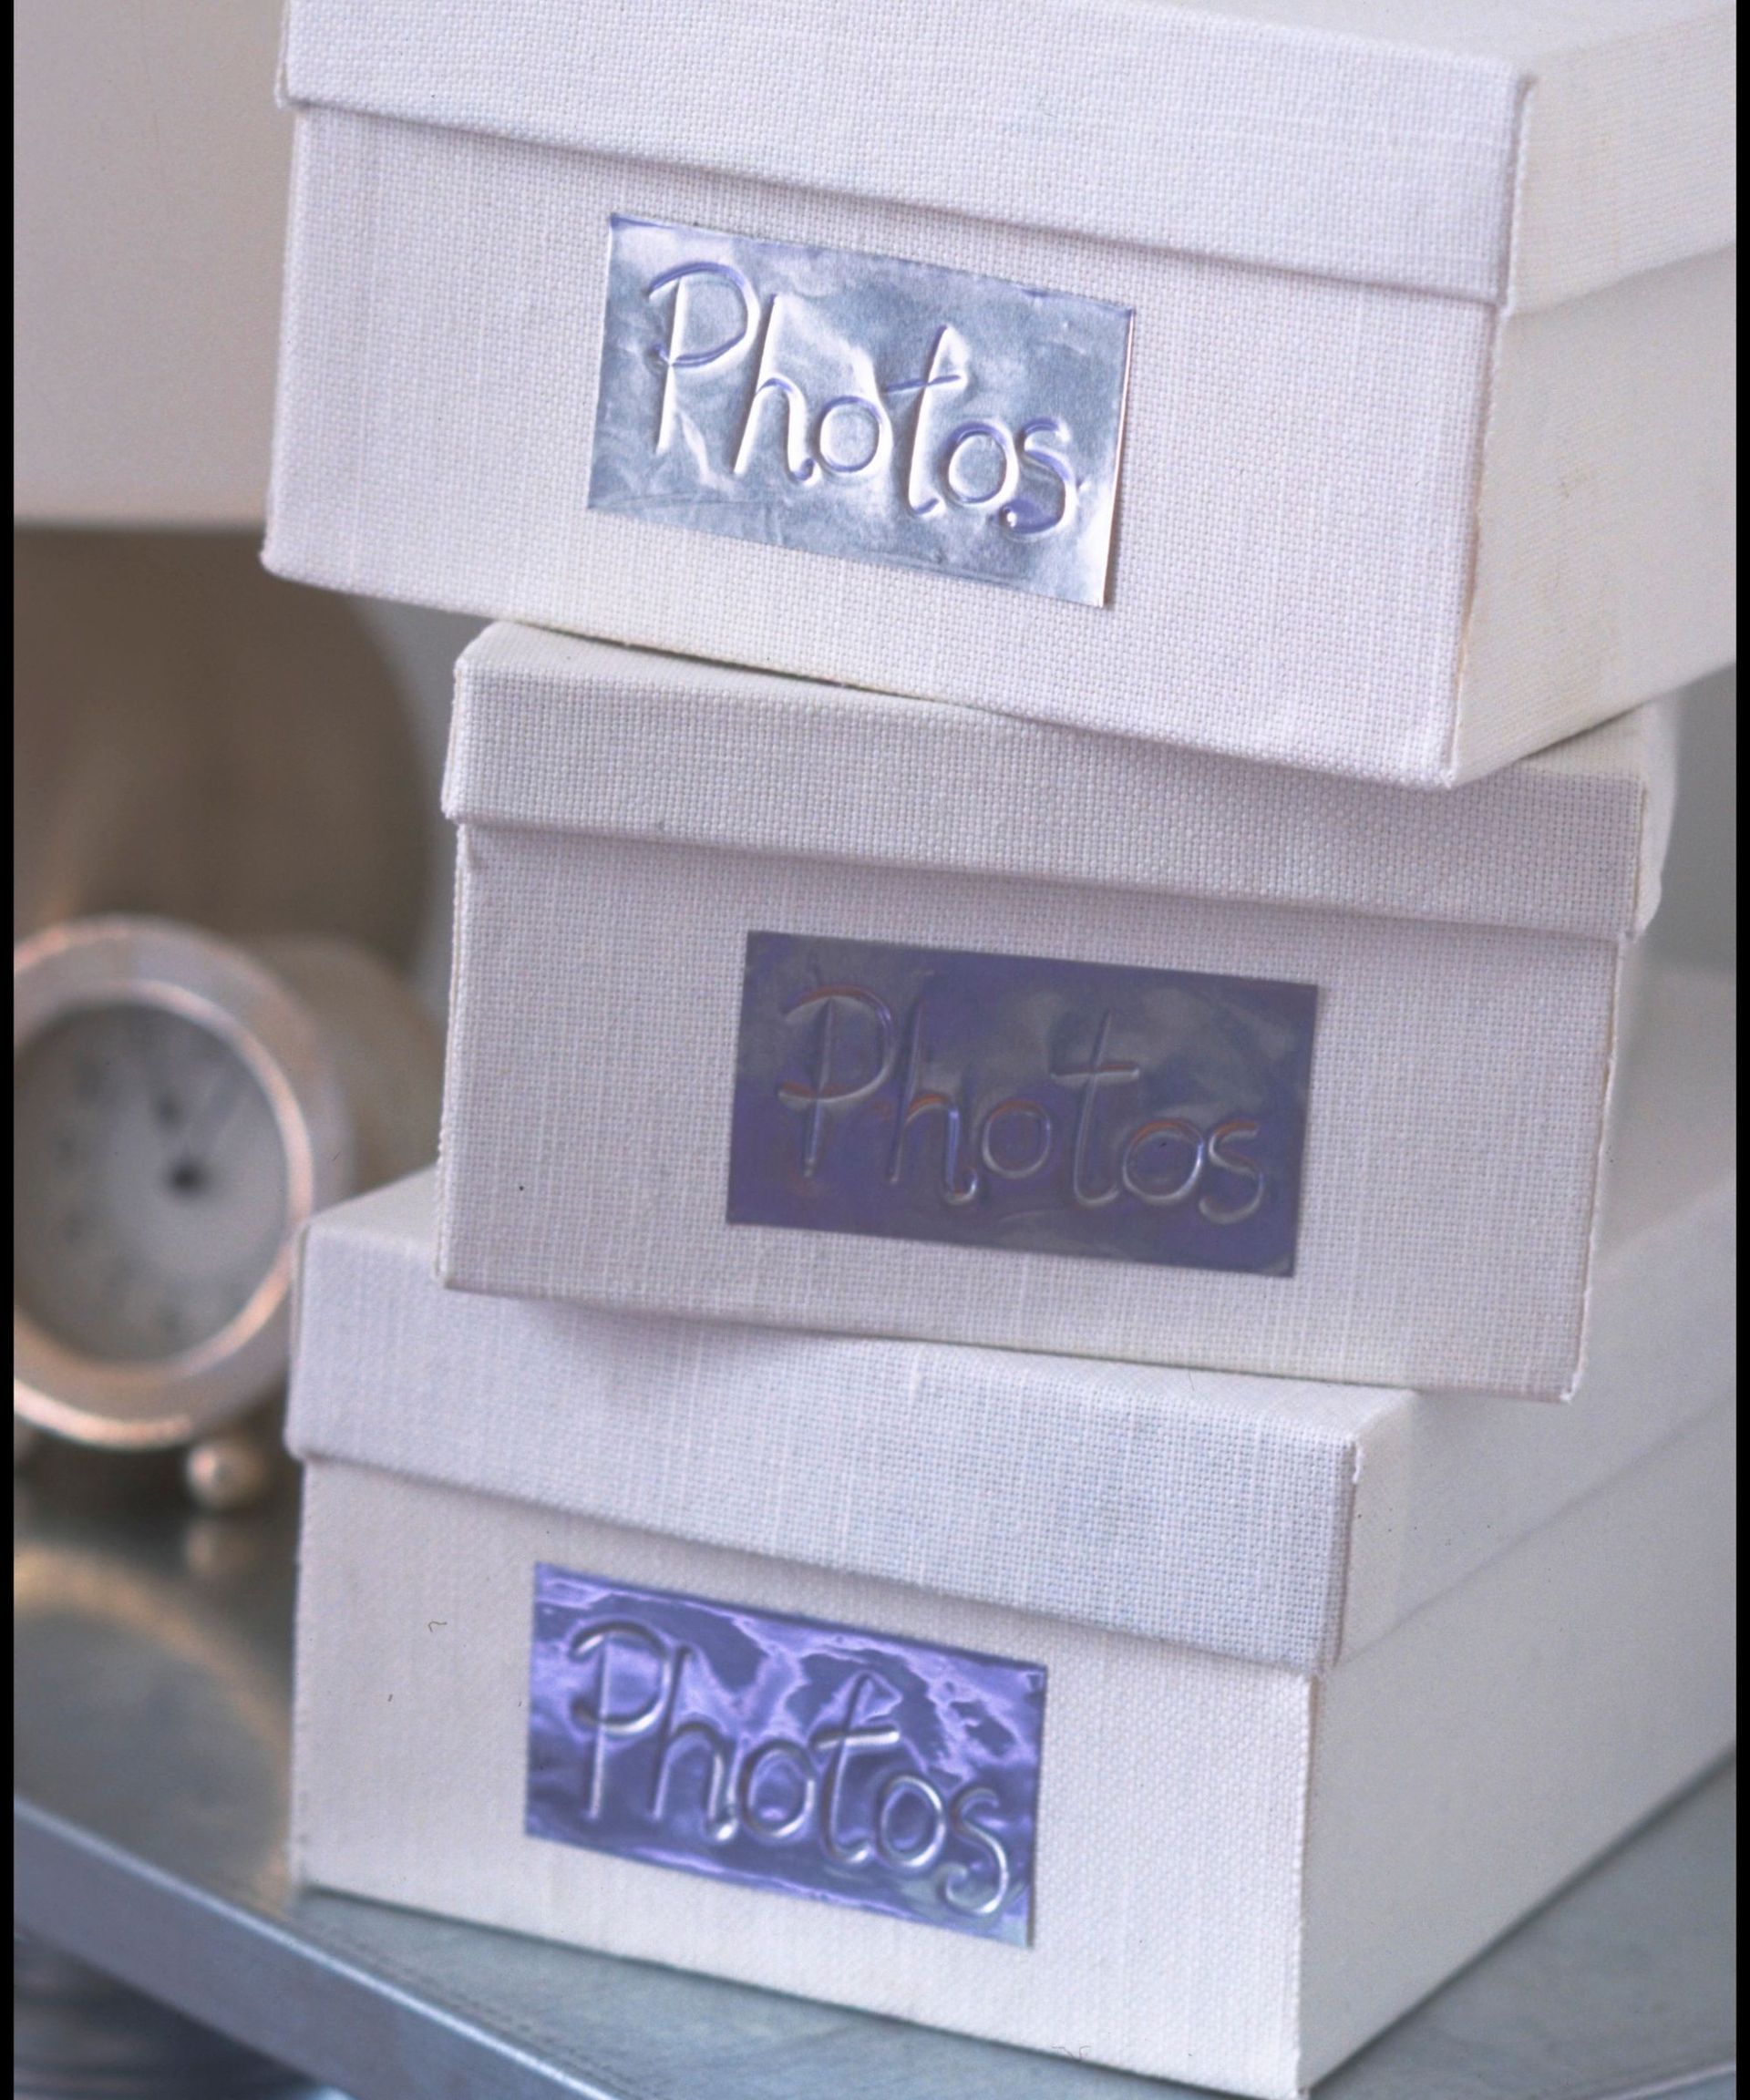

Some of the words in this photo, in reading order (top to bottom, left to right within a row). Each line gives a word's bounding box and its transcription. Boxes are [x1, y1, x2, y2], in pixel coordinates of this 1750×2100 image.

[647, 261, 1077, 538] Photos
[777, 985, 1265, 1225] Photos
[569, 1620, 1009, 1915] Photos
